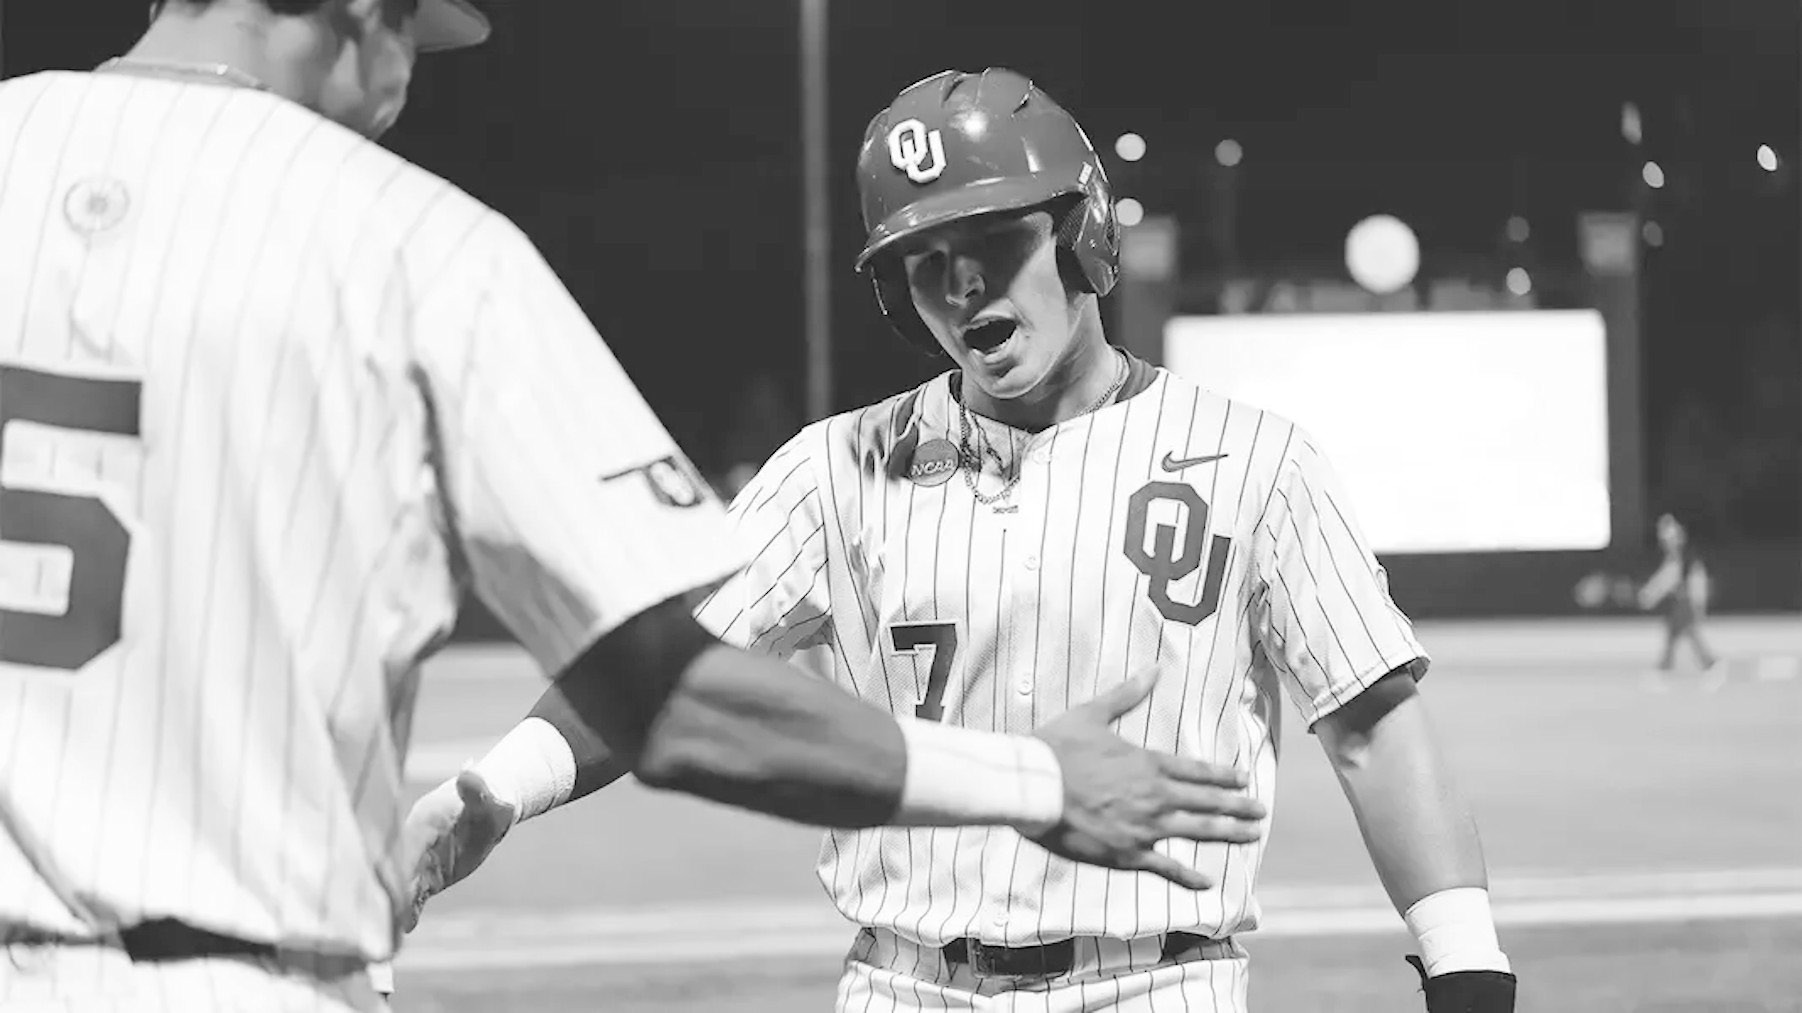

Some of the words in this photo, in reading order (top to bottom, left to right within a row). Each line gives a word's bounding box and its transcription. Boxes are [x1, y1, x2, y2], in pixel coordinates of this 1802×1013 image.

[888, 118, 947, 184] OU
[0, 364, 142, 670] 5
[910, 460, 954, 477] NCAA
[1123, 481, 1232, 627] OU
[890, 622, 958, 722] 7
